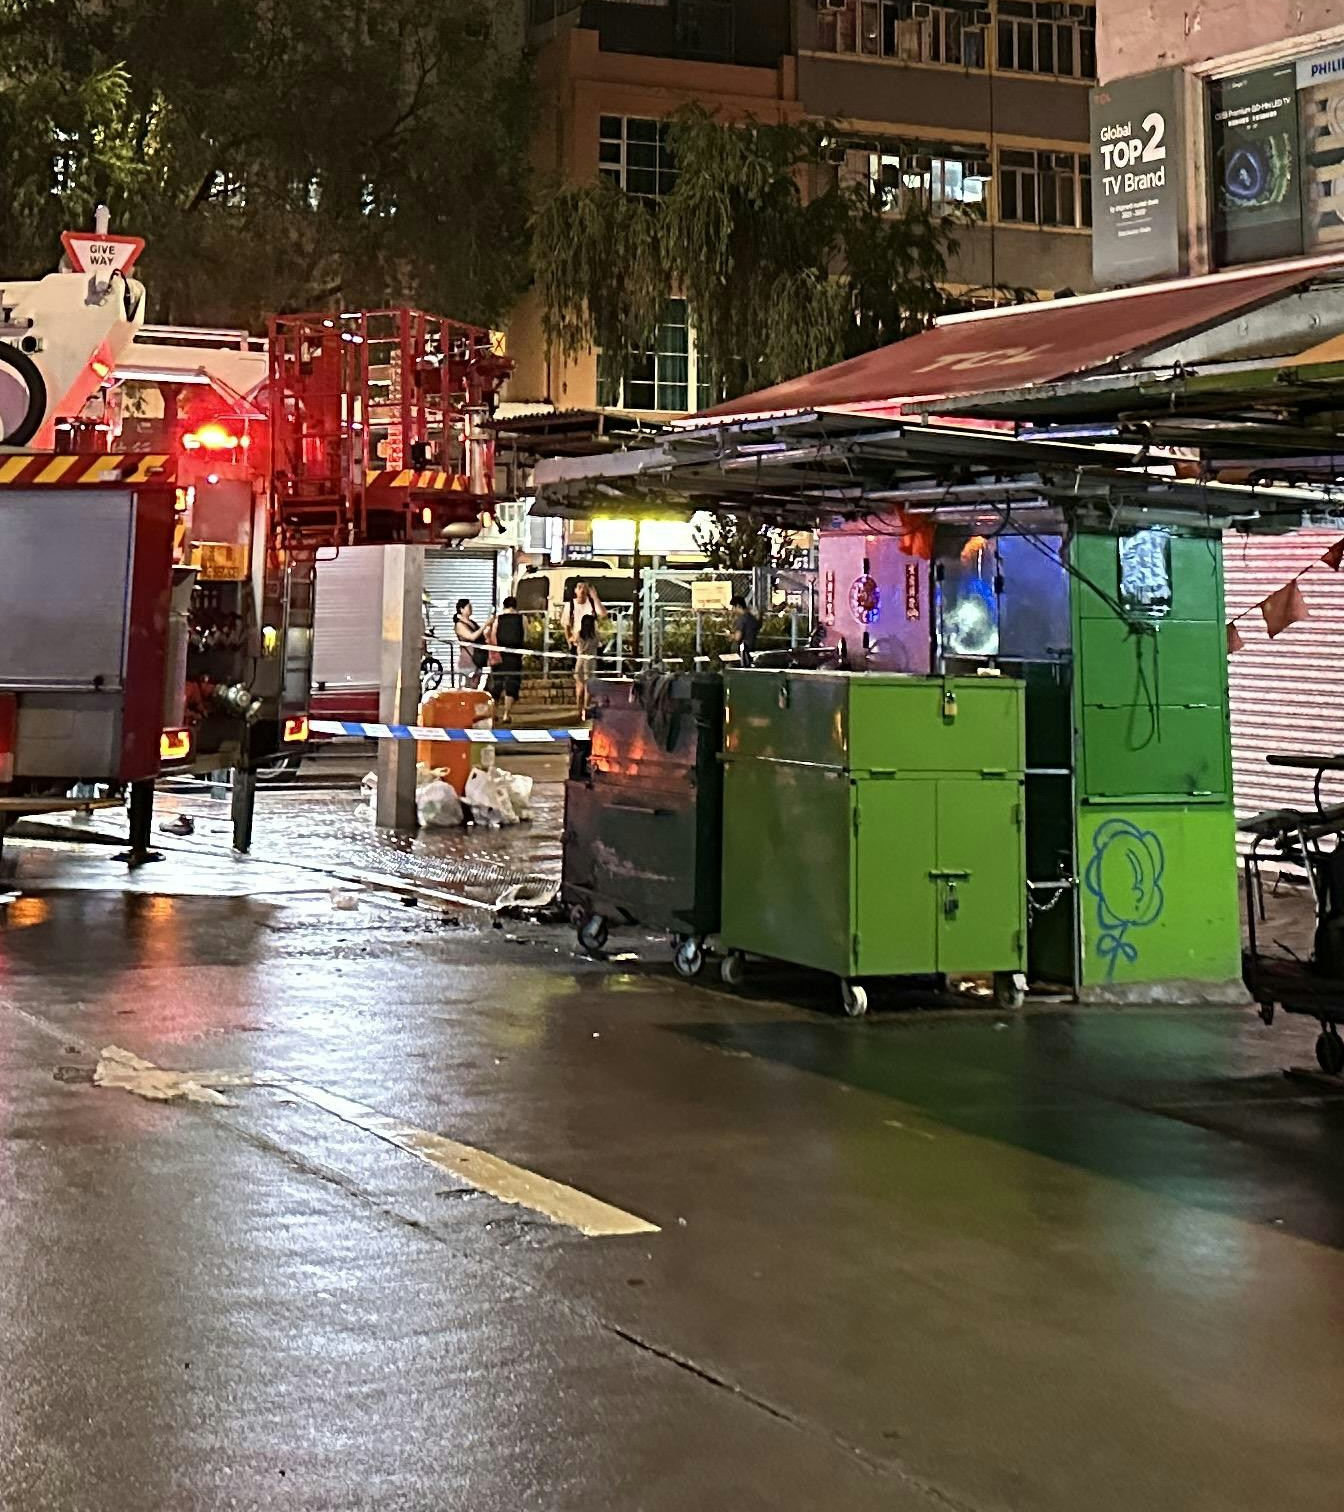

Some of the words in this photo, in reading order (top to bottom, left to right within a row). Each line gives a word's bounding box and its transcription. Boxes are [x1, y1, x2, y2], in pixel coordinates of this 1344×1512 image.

[1100, 121, 1132, 141] Global
[1102, 174, 1121, 196] TV
[1124, 165, 1165, 193] Brand
[90, 244, 115, 255] GIVE
[90, 255, 114, 266] WAY
[911, 343, 1056, 375] TCL
